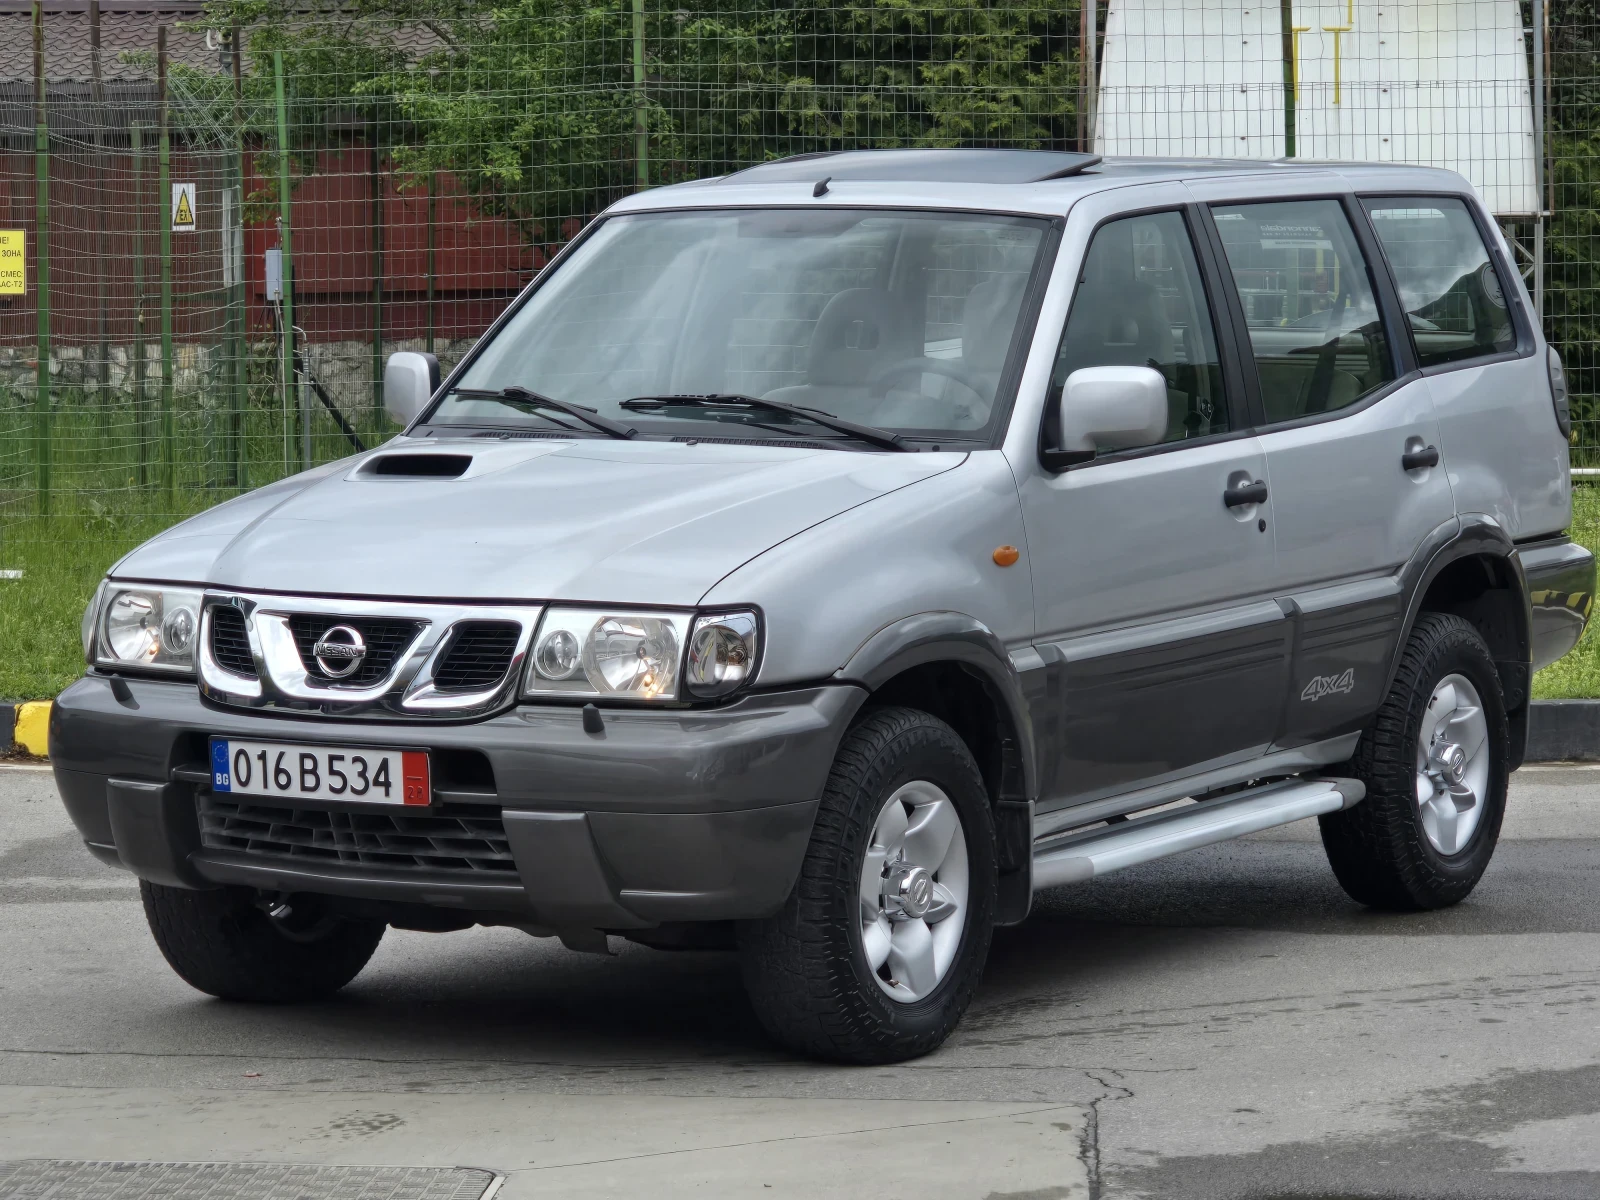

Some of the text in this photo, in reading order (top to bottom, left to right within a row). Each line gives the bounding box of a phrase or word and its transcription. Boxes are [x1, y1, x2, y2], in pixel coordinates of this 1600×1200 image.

[180, 209, 187, 221] EX
[2, 249, 21, 257] ЗОНА
[0, 280, 22, 288] АС-Т2
[315, 643, 357, 657] NISSAN
[215, 772, 229, 785] BG
[233, 748, 392, 797] 016B534
